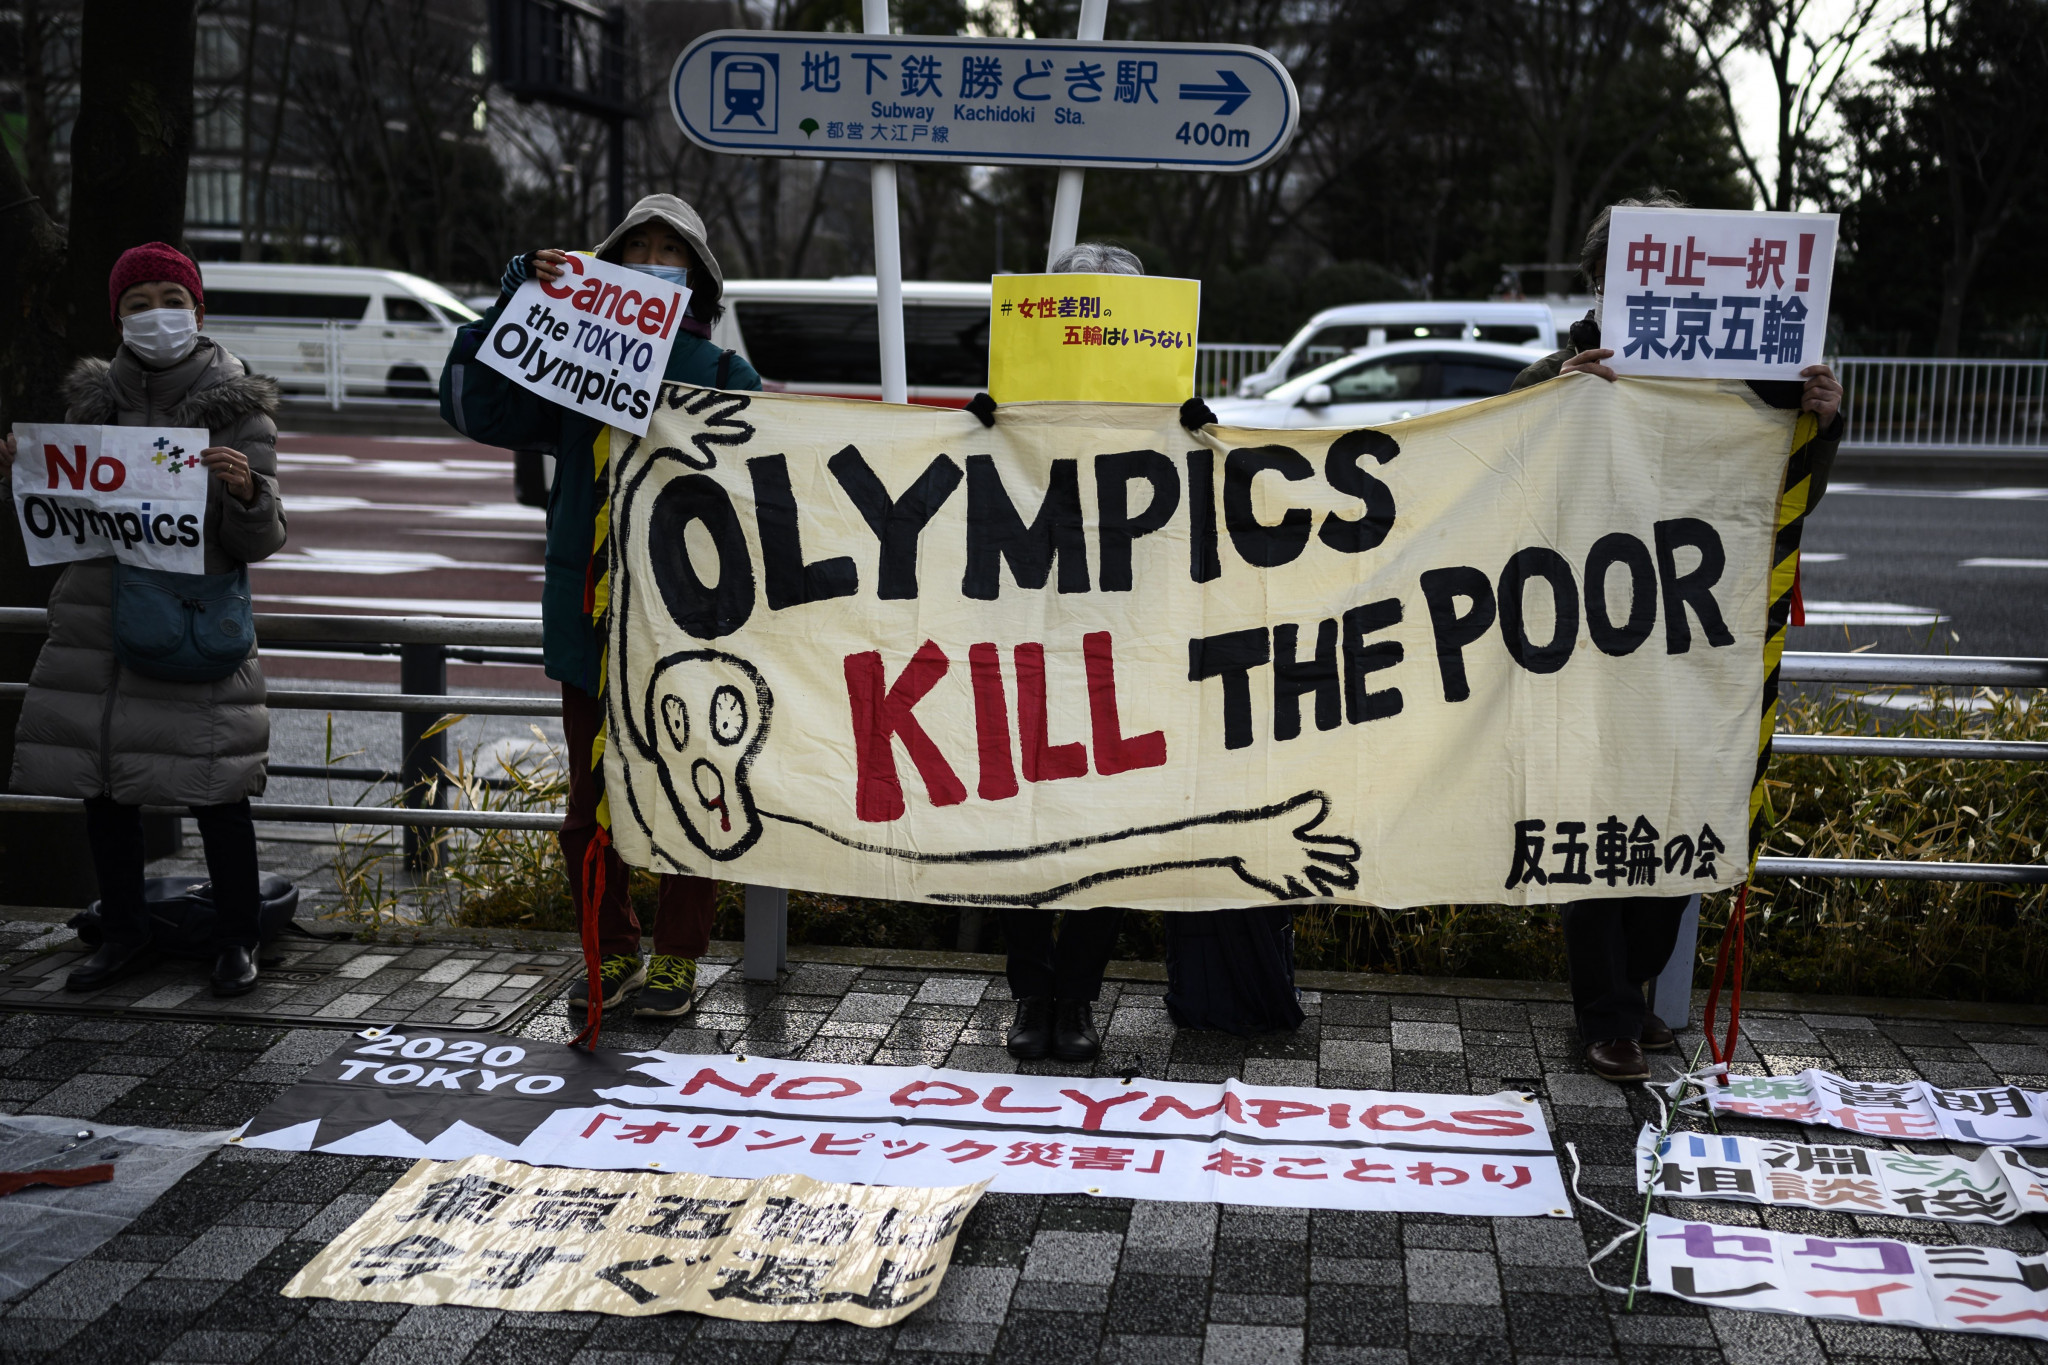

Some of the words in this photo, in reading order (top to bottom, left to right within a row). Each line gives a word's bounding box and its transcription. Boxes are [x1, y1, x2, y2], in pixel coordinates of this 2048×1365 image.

[870, 101, 935, 124] Subway
[953, 103, 1036, 124] Kachidoki
[1053, 107, 1086, 126] Sta.
[1175, 121, 1250, 148] 400m
[1626, 233, 1816, 293] 中止一択!
[539, 254, 681, 340] Cancel
[525, 303, 569, 342] the
[572, 318, 653, 373] TOKYO
[1062, 325, 1192, 349] 五輪はいらない
[1623, 290, 1808, 365] 東京五輪
[492, 322, 651, 420] Olympics
[43, 443, 126, 492] No
[23, 495, 200, 550] Olympics
[648, 428, 1400, 641] OLYMPICS
[843, 630, 1167, 823] KILL
[1187, 597, 1405, 751] THE
[1419, 517, 1736, 703] POOR
[1504, 814, 1726, 890] 反五輪の会
[337, 1059, 566, 1095] TOKYO
[354, 1035, 526, 1067] 2020
[680, 1067, 863, 1101] NO
[889, 1079, 1537, 1137] OLYMPICS
[1202, 1148, 1533, 1190] おことわり
[1645, 1162, 2048, 1222] 相談役
